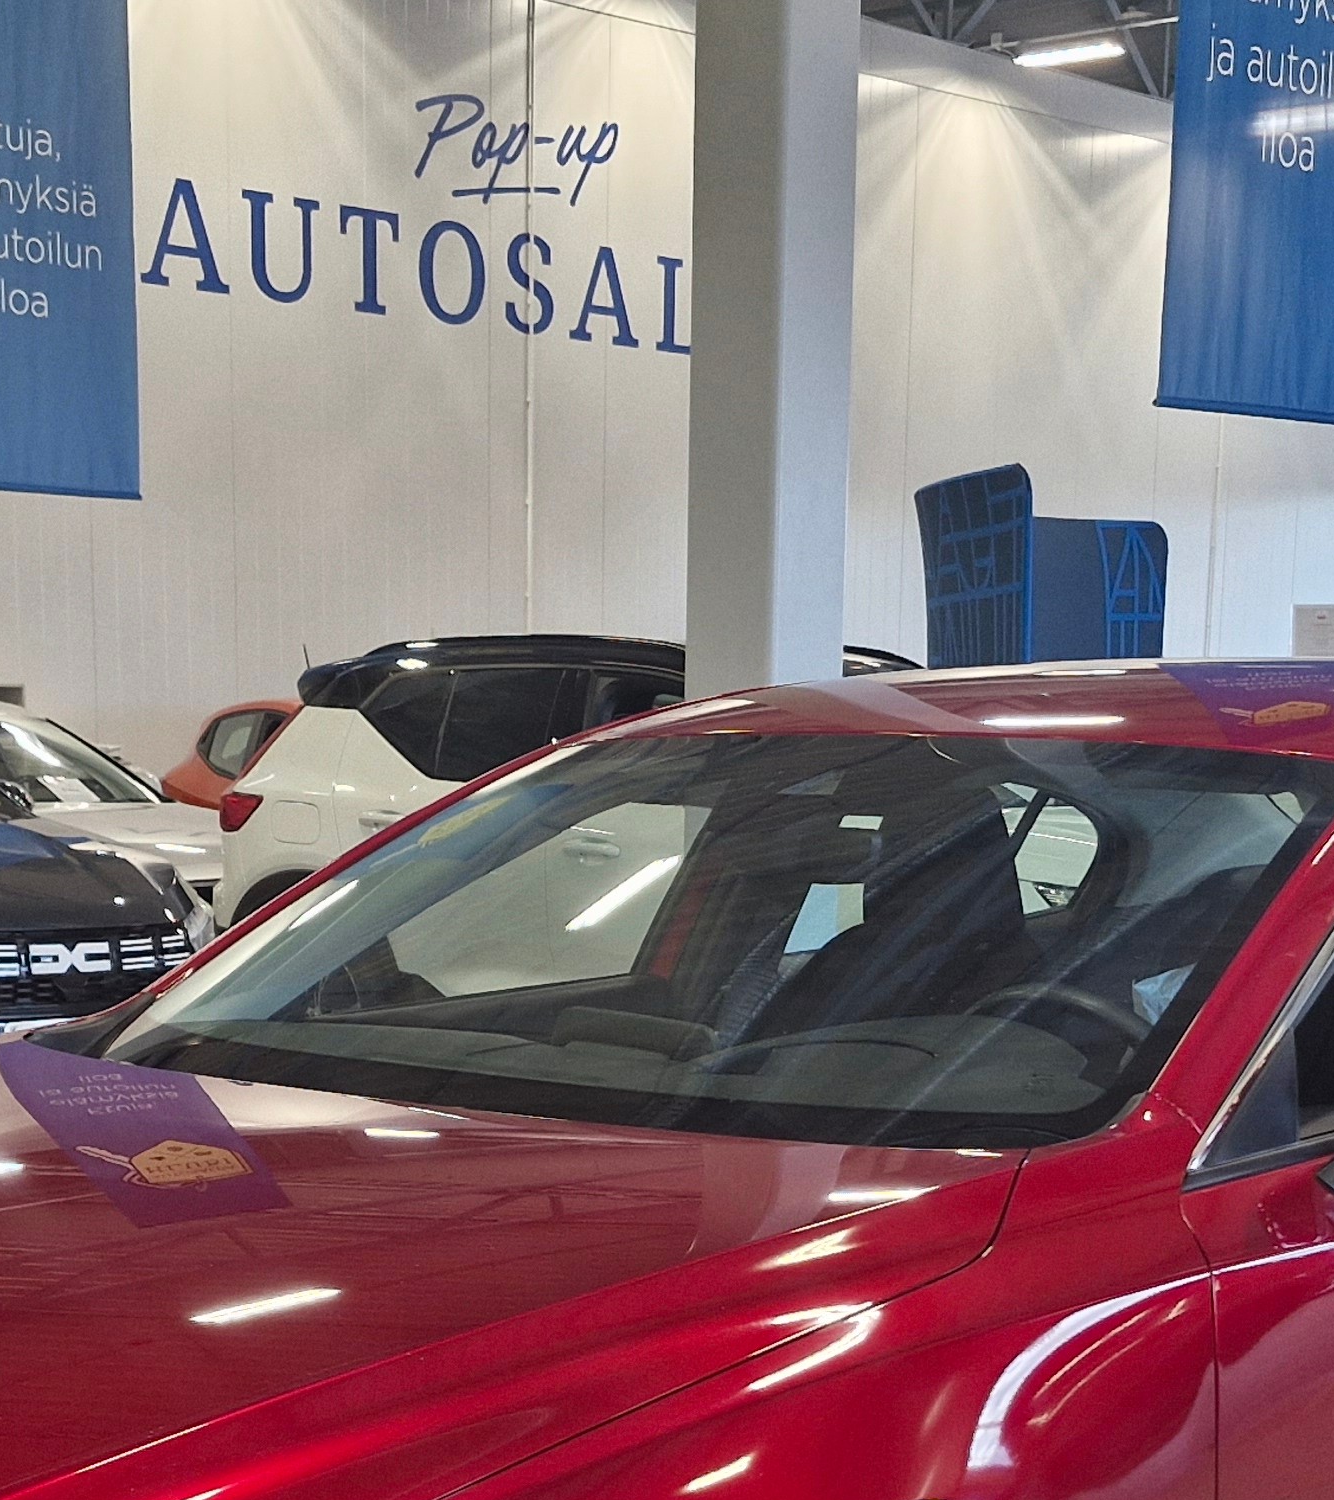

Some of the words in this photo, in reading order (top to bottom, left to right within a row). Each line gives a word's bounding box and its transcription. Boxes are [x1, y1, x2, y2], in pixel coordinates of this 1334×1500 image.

[1206, 22, 1235, 82] ja
[415, 93, 619, 206] Pop-up
[1261, 113, 1315, 172] iloa
